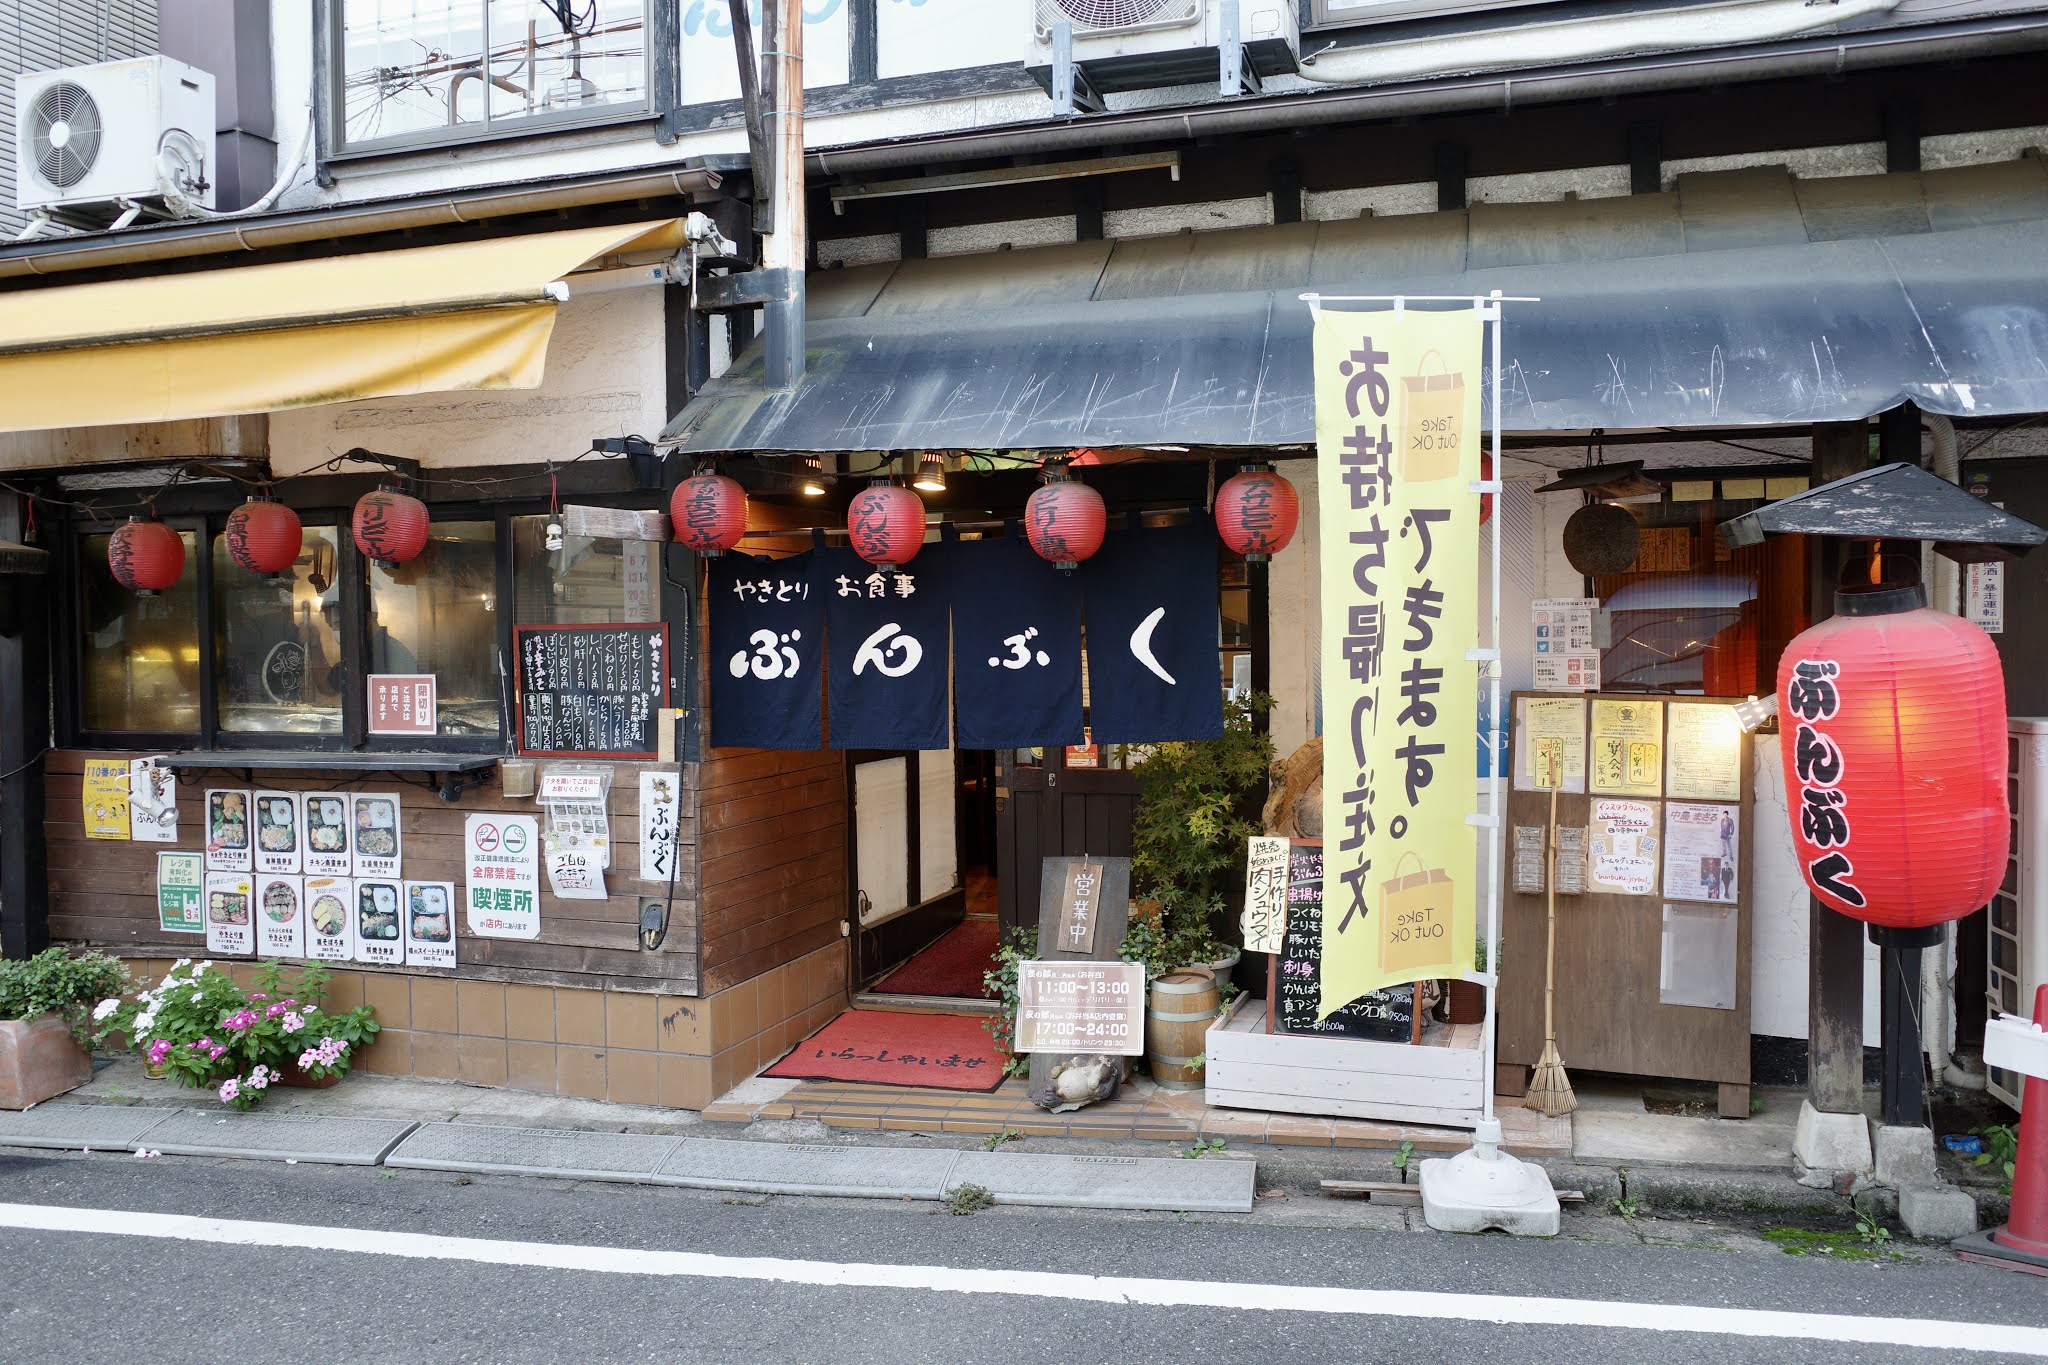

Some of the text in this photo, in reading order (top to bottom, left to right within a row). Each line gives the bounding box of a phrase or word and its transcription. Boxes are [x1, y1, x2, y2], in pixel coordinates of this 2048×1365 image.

[854, 494, 896, 562] ぶんぶく
[628, 573, 638, 582] 13
[733, 573, 916, 602] やきとり お食事
[628, 590, 638, 600] 20
[648, 633, 662, 696] やきとり
[1789, 659, 1867, 907] ぶんぶく
[650, 808, 670, 875] ぶんぶく
[472, 866, 532, 880] 全席禁煙ですが
[472, 886, 533, 913] 喫煙所
[1269, 866, 1286, 918] 手作り
[1070, 873, 1095, 945] 営業中
[480, 918, 528, 930] が店内にあります
[1284, 960, 1315, 977] 刺身
[816, 1048, 987, 1068] いらっしゃいませ
